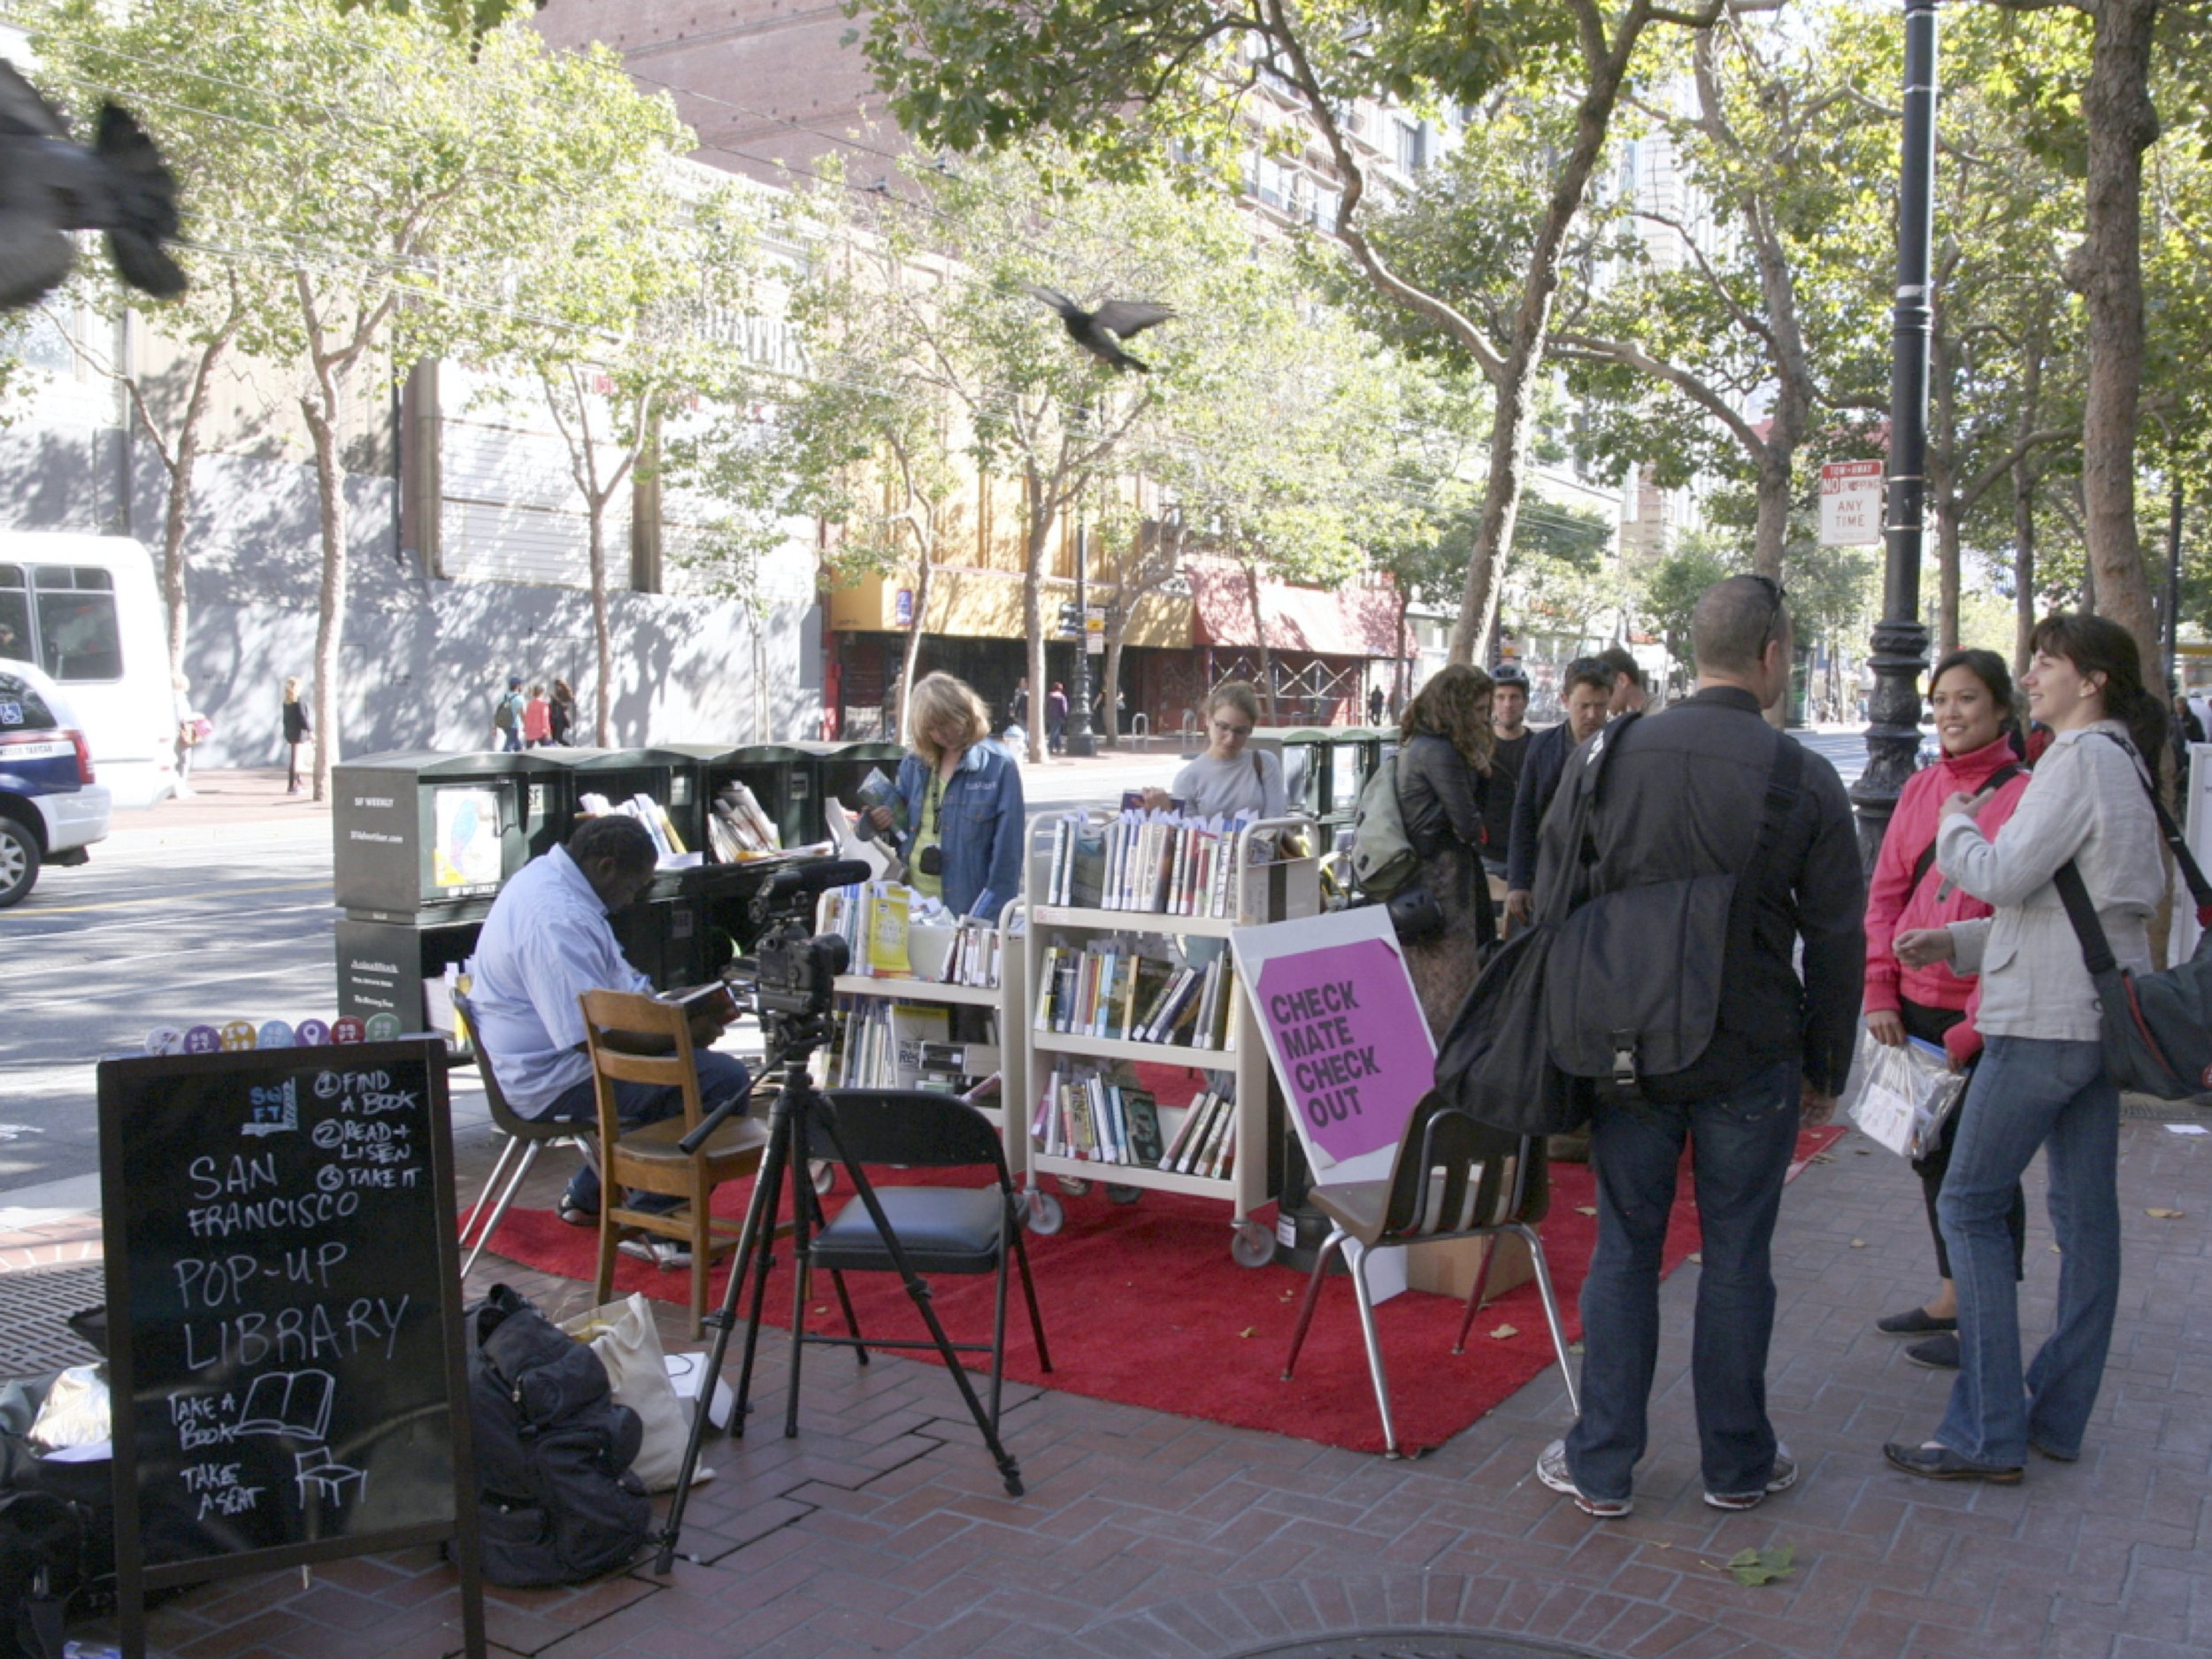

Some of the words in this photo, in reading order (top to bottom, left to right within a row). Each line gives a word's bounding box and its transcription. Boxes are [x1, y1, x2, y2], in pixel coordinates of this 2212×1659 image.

[1823, 478, 1839, 494] NO
[1835, 514, 1865, 527] TIME
[1838, 500, 1863, 511] ANY
[365, 797, 395, 808] WEEKLY
[1271, 980, 1361, 1025] CHECK
[1280, 1016, 1355, 1060] MATE
[342, 1069, 390, 1094] FIND
[1295, 1044, 1382, 1094] CHECK
[252, 1106, 281, 1124] FT
[341, 1096, 355, 1113] A
[1308, 1086, 1363, 1128] OUT
[188, 1152, 279, 1200] SAN
[347, 1166, 396, 1188] TAKE
[403, 1166, 423, 1188] IT
[187, 1191, 358, 1237] FRANCISCO
[173, 1241, 348, 1310] POP-UP
[184, 1294, 410, 1371] LIBRARY
[167, 1392, 217, 1426] TAKE
[221, 1392, 235, 1412] A
[180, 1463, 242, 1494] TAKE
[196, 1492, 214, 1521] A
